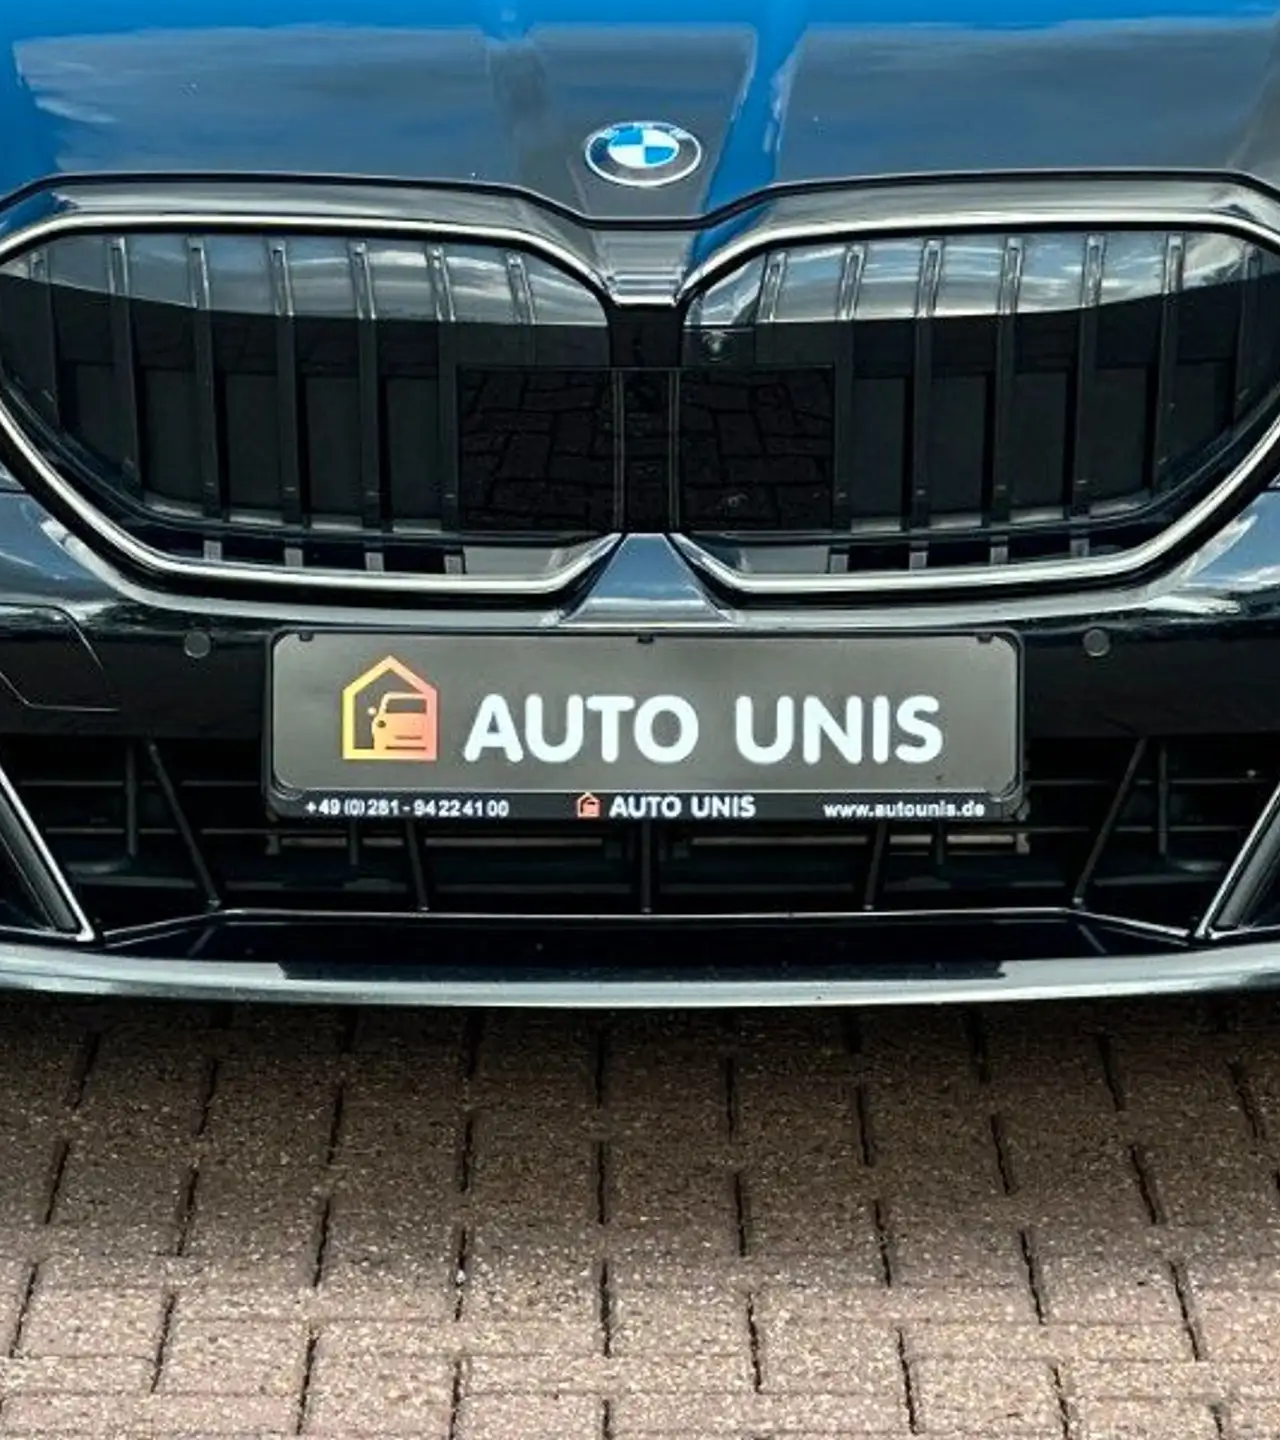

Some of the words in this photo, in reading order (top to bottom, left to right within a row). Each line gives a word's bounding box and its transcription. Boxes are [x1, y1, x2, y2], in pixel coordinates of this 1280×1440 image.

[463, 693, 700, 764] AUTO
[735, 693, 944, 764] UNIS
[608, 794, 684, 818] AUTO
[690, 794, 757, 818] UNIS
[822, 797, 987, 818] www.autounis.de
